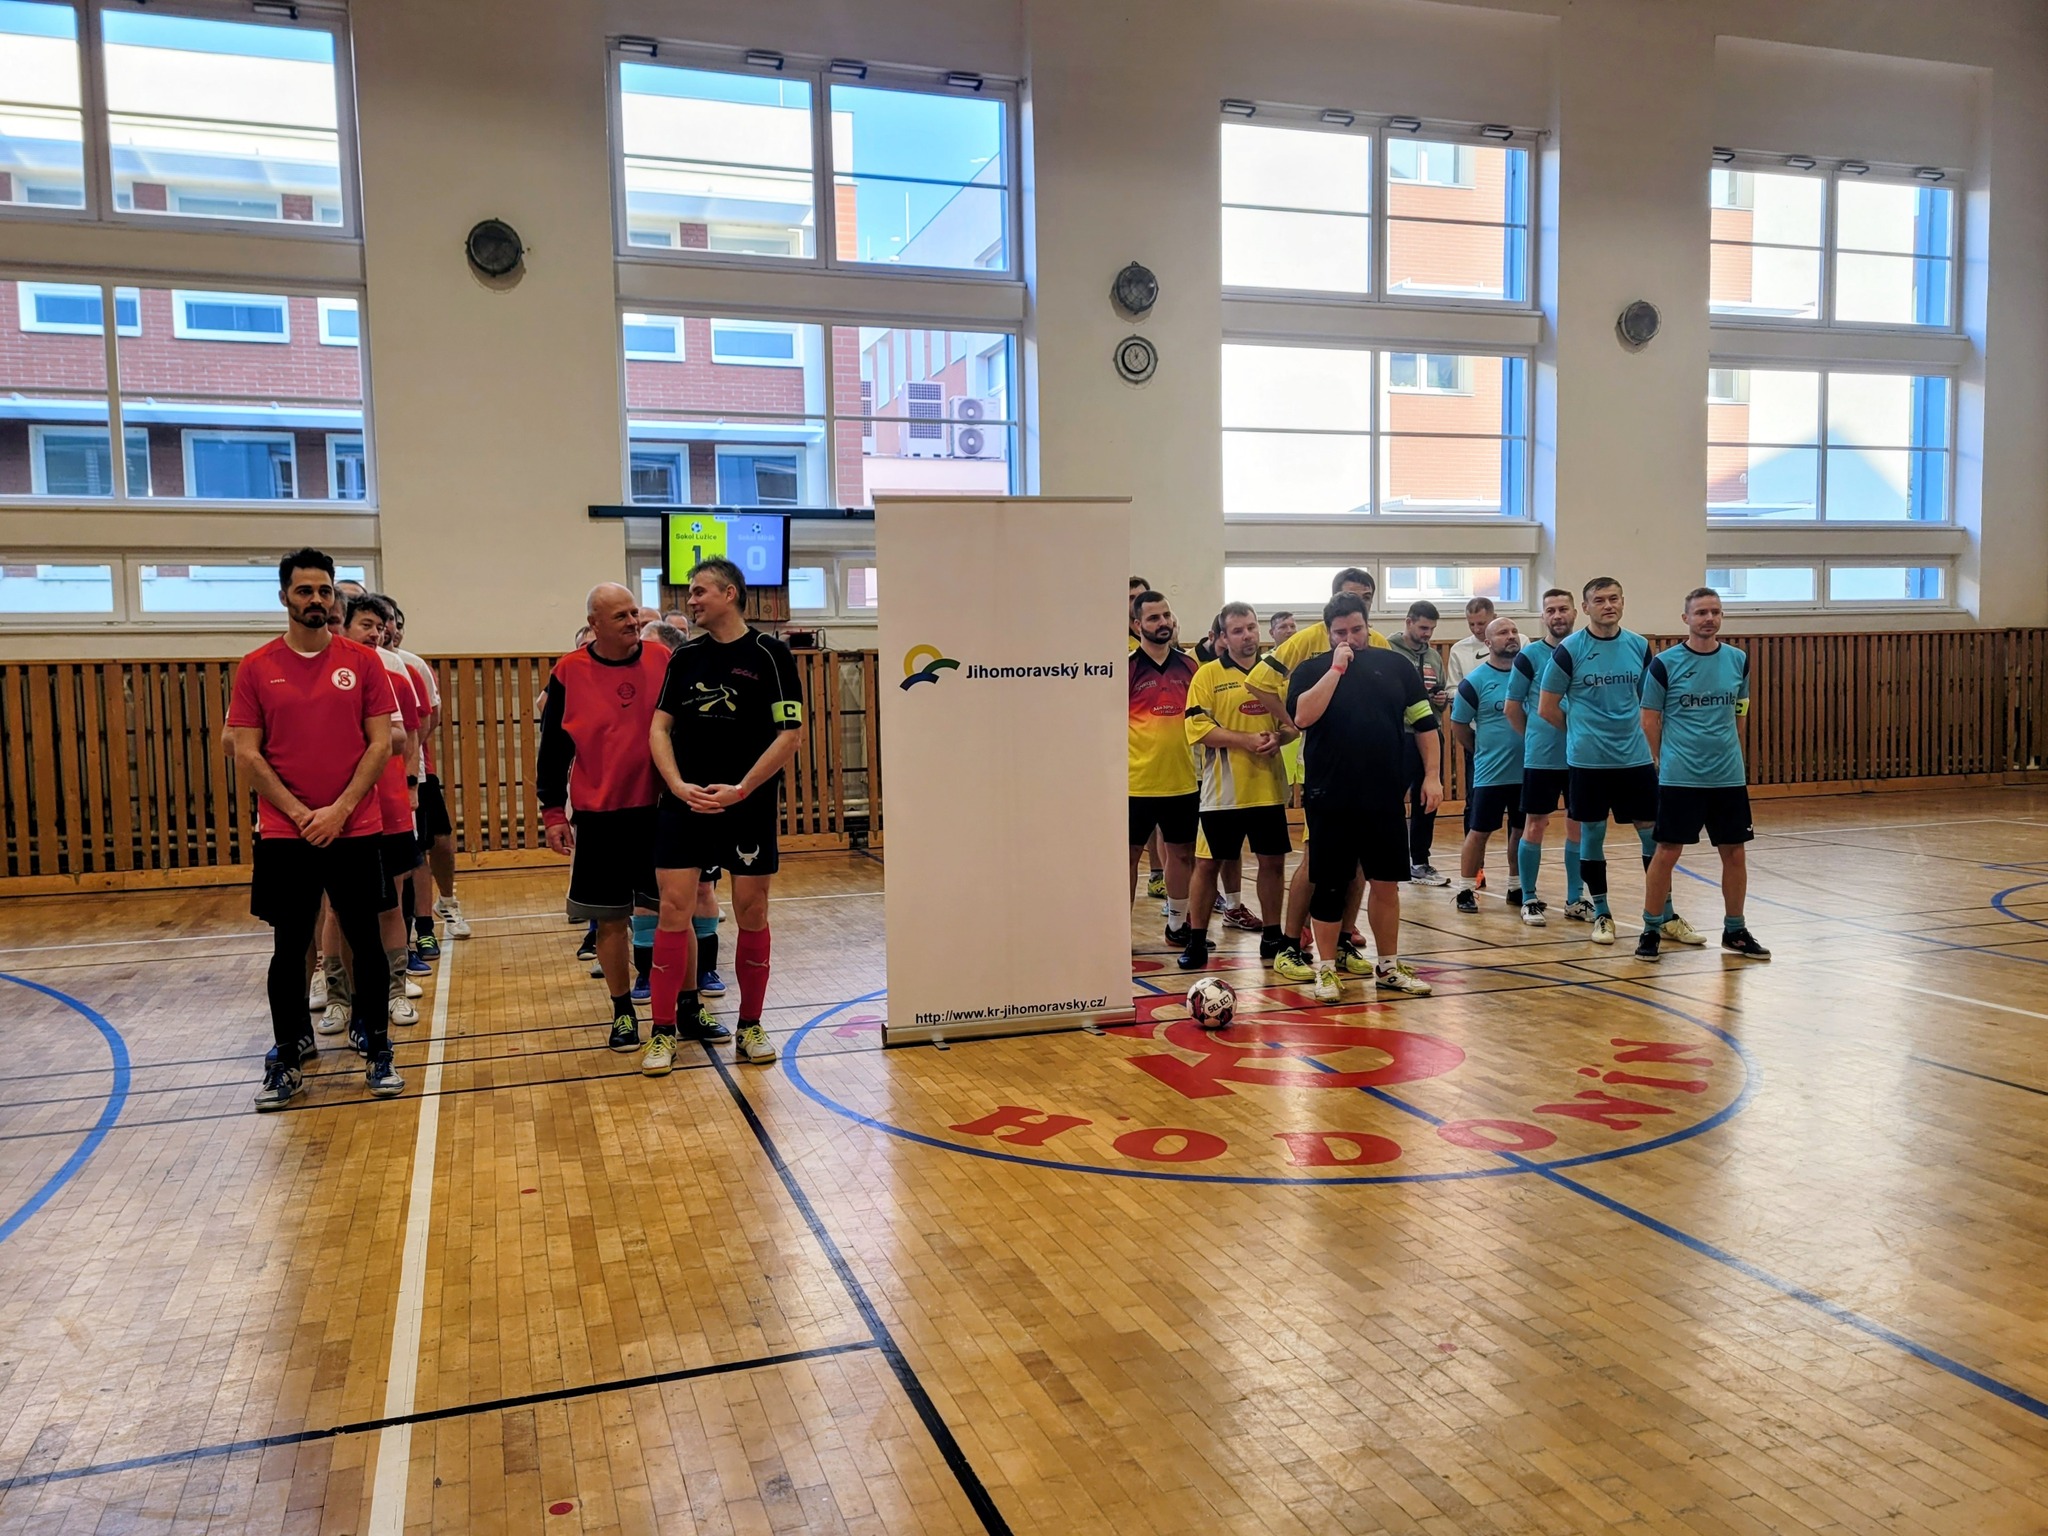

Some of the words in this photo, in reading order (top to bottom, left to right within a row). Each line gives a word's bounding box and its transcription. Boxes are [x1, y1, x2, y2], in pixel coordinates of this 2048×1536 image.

[695, 532, 717, 540] Lužice
[692, 545, 702, 567] 1
[746, 545, 767, 571] 0
[966, 662, 1079, 679] Jihomoravský
[1084, 661, 1114, 678] kraj
[1583, 671, 1639, 687] Chemila
[783, 704, 796, 718] C
[1735, 702, 1744, 714] C
[915, 996, 1107, 1025] http://www.kr-jihomoravsky.cz/
[1207, 994, 1232, 1014] SELECT
